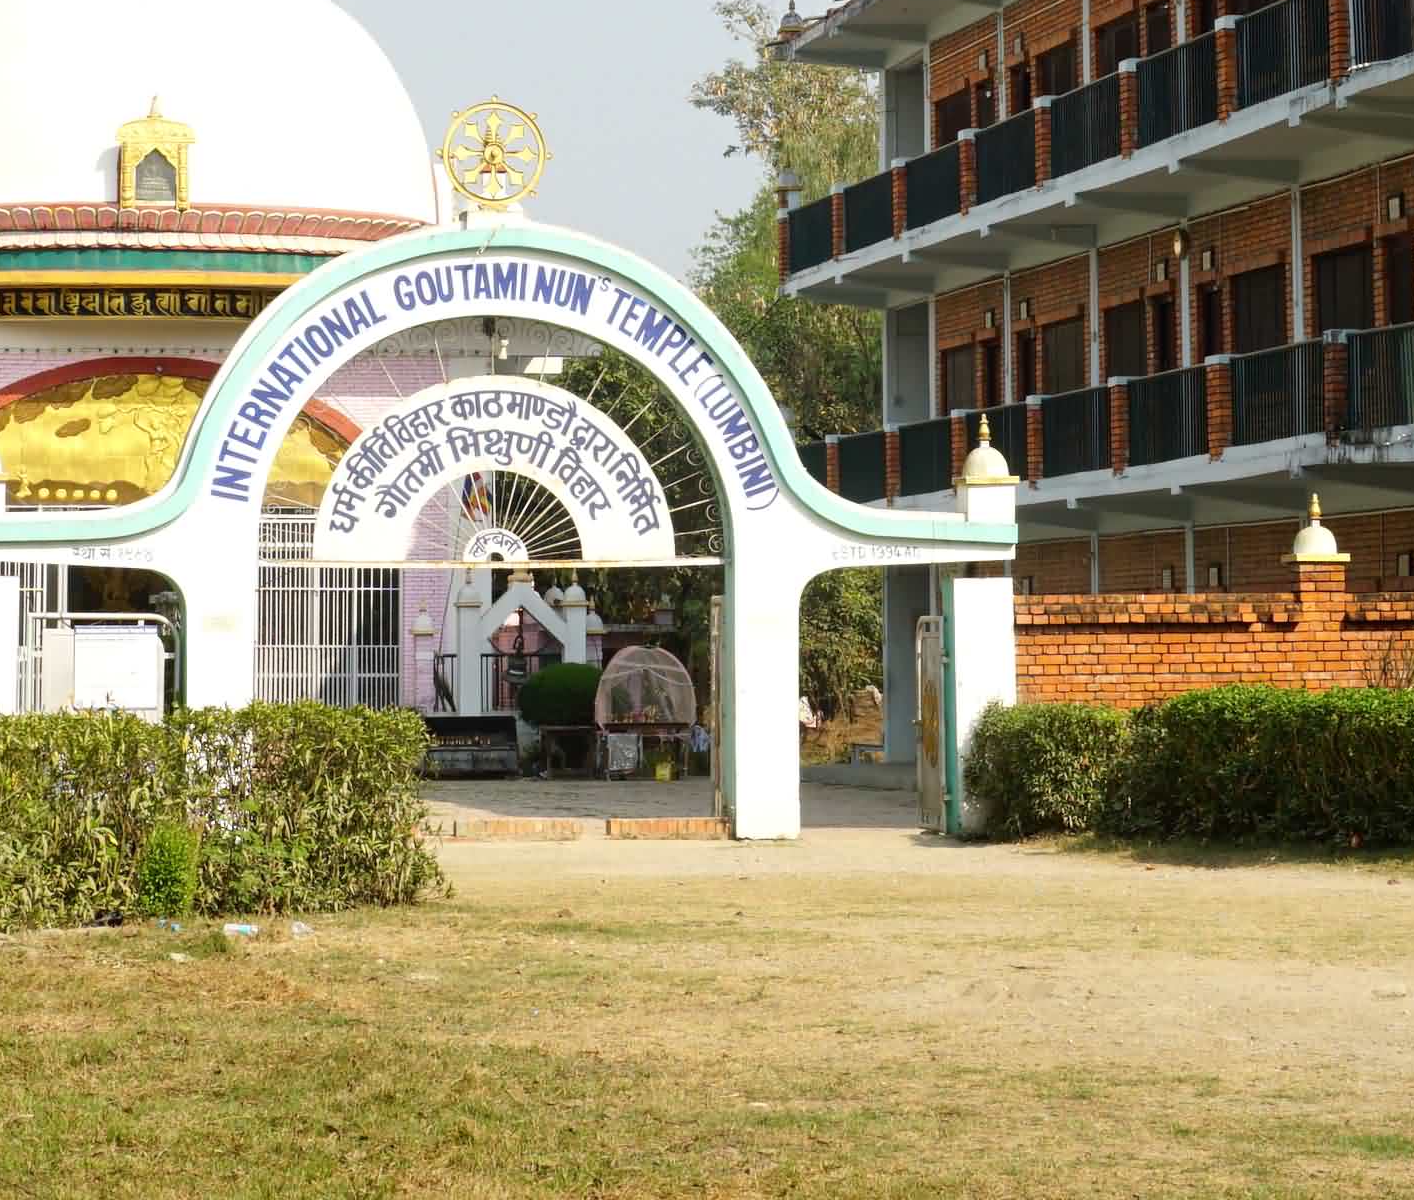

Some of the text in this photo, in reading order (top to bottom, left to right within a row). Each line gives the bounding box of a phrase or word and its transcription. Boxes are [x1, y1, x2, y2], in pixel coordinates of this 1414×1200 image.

[211, 291, 387, 502] INTERNATIONAL
[394, 262, 526, 311] GOUTAMI
[606, 287, 715, 386] TEMPLE
[694, 374, 780, 511] (LUMBINI)
[329, 482, 366, 534] धर्म
[385, 399, 449, 455] विहार
[612, 452, 661, 536] निर्मित
[446, 426, 555, 467] भिक्षुणी
[551, 446, 612, 521] विहार
